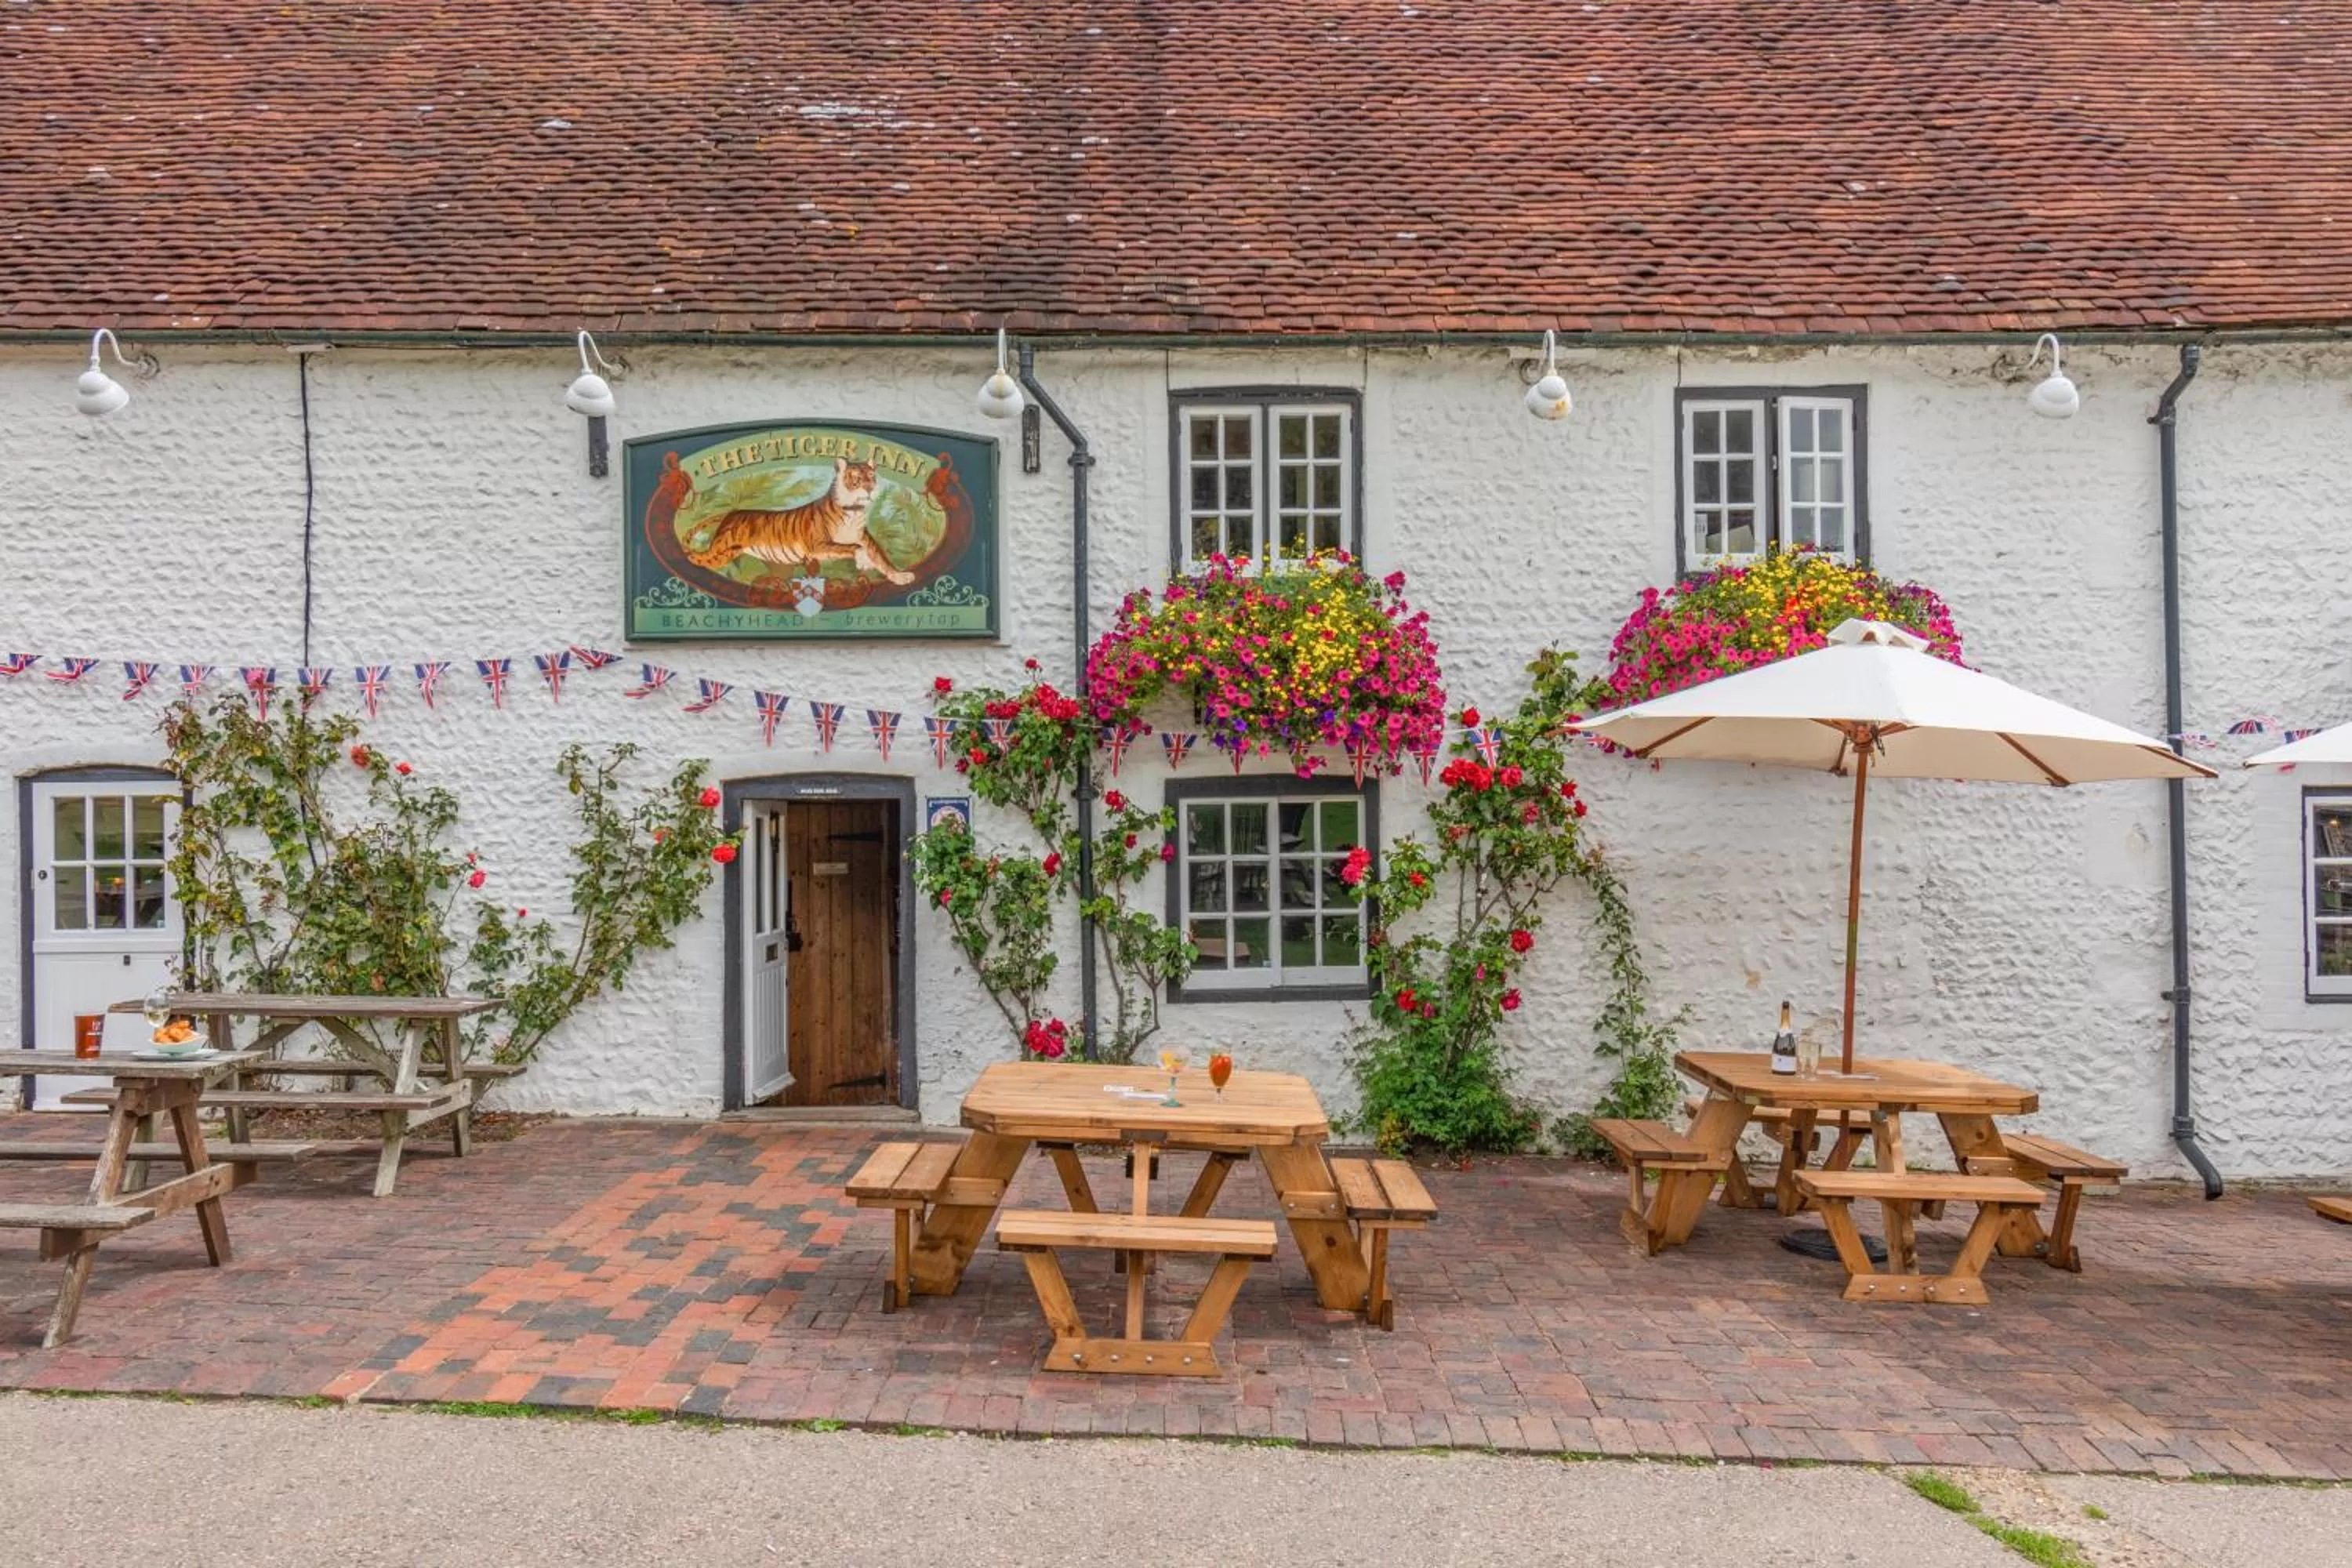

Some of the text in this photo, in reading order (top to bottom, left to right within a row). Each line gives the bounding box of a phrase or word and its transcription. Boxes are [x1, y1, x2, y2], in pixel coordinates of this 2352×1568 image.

[700, 435, 925, 479] THE TIGER INN
